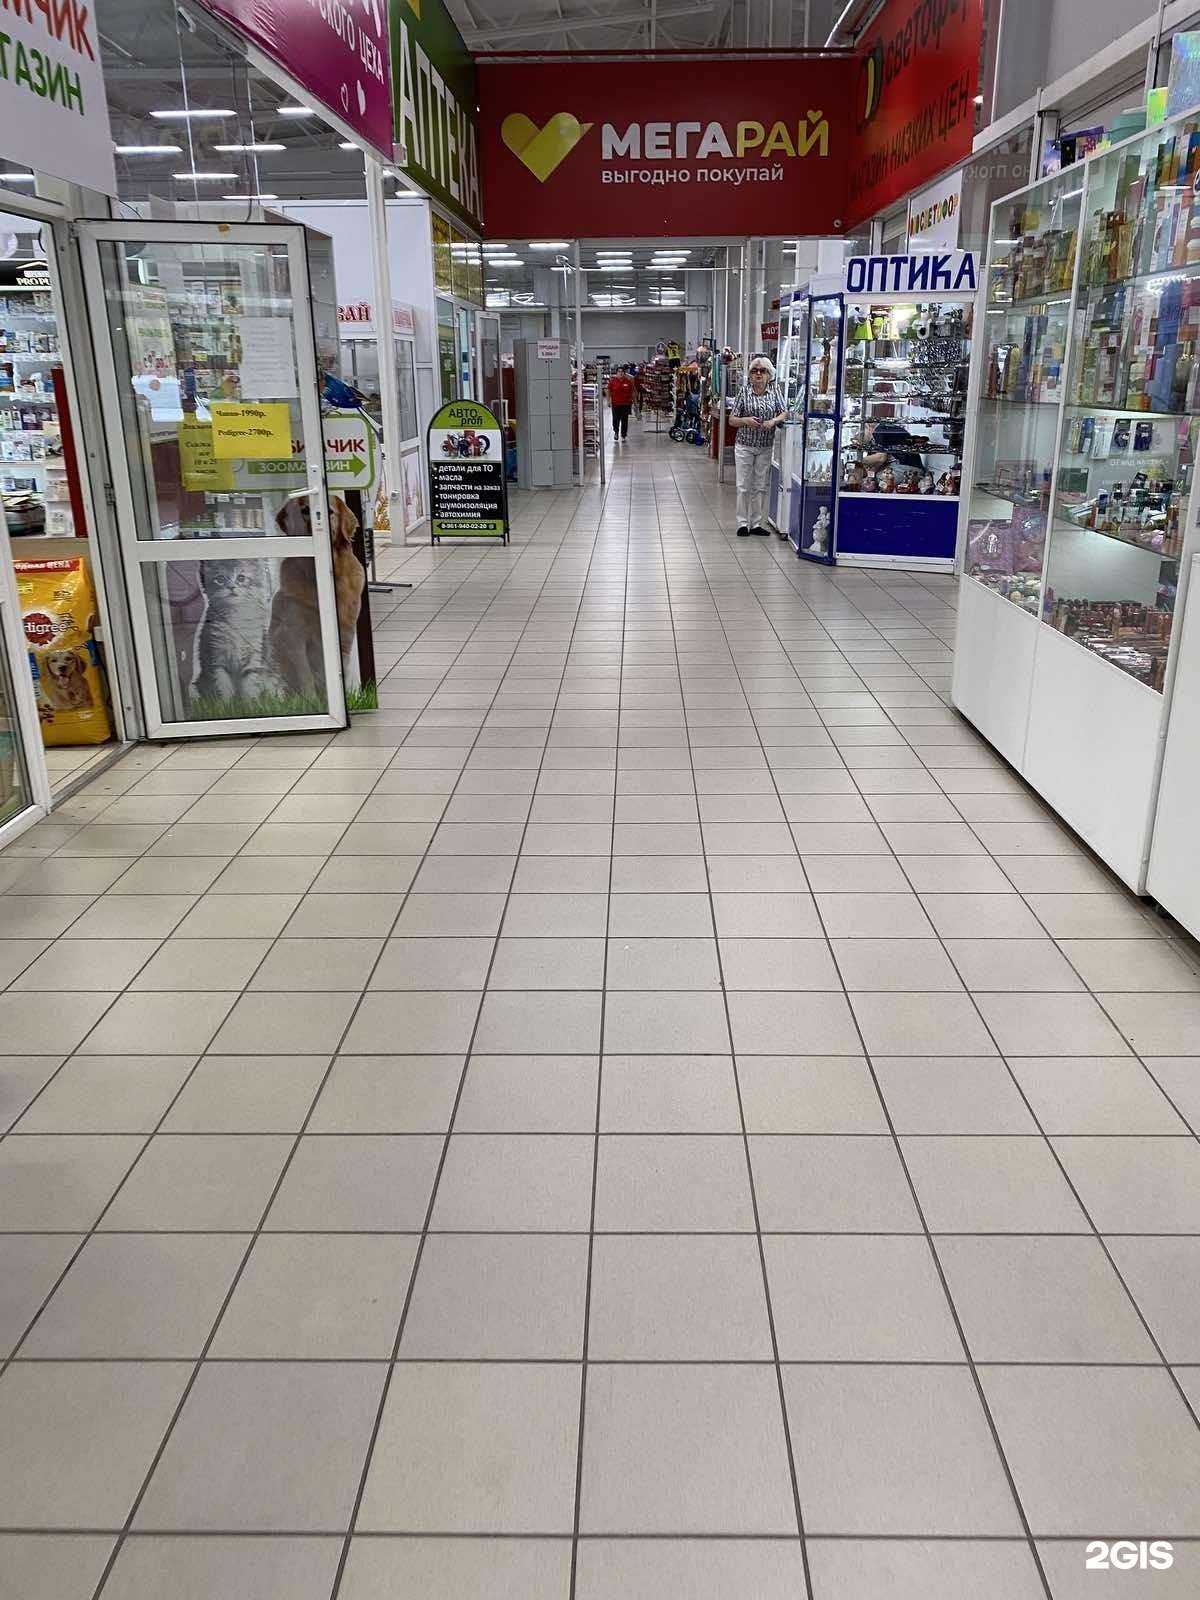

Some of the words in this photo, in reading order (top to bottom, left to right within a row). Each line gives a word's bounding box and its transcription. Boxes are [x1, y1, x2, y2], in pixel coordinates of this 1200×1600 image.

[358, 26, 385, 85] ЦЕХА
[400, 16, 483, 223] АПТЕКА
[890, 101, 935, 171] НИЗКИХ
[938, 69, 971, 142] ЦЕН
[602, 110, 829, 160] МЕГАРАЙ
[602, 167, 691, 185] выгодно
[696, 163, 785, 186] покупай
[846, 252, 977, 293] ОПТИКА
[461, 416, 483, 427] profi
[438, 464, 466, 473] детали
[467, 465, 482, 473] для
[482, 464, 494, 472] ТО
[438, 474, 463, 482] масла
[439, 493, 480, 501] тонировка
[439, 502, 498, 511] шумоизоляция
[24, 622, 67, 634] digree
